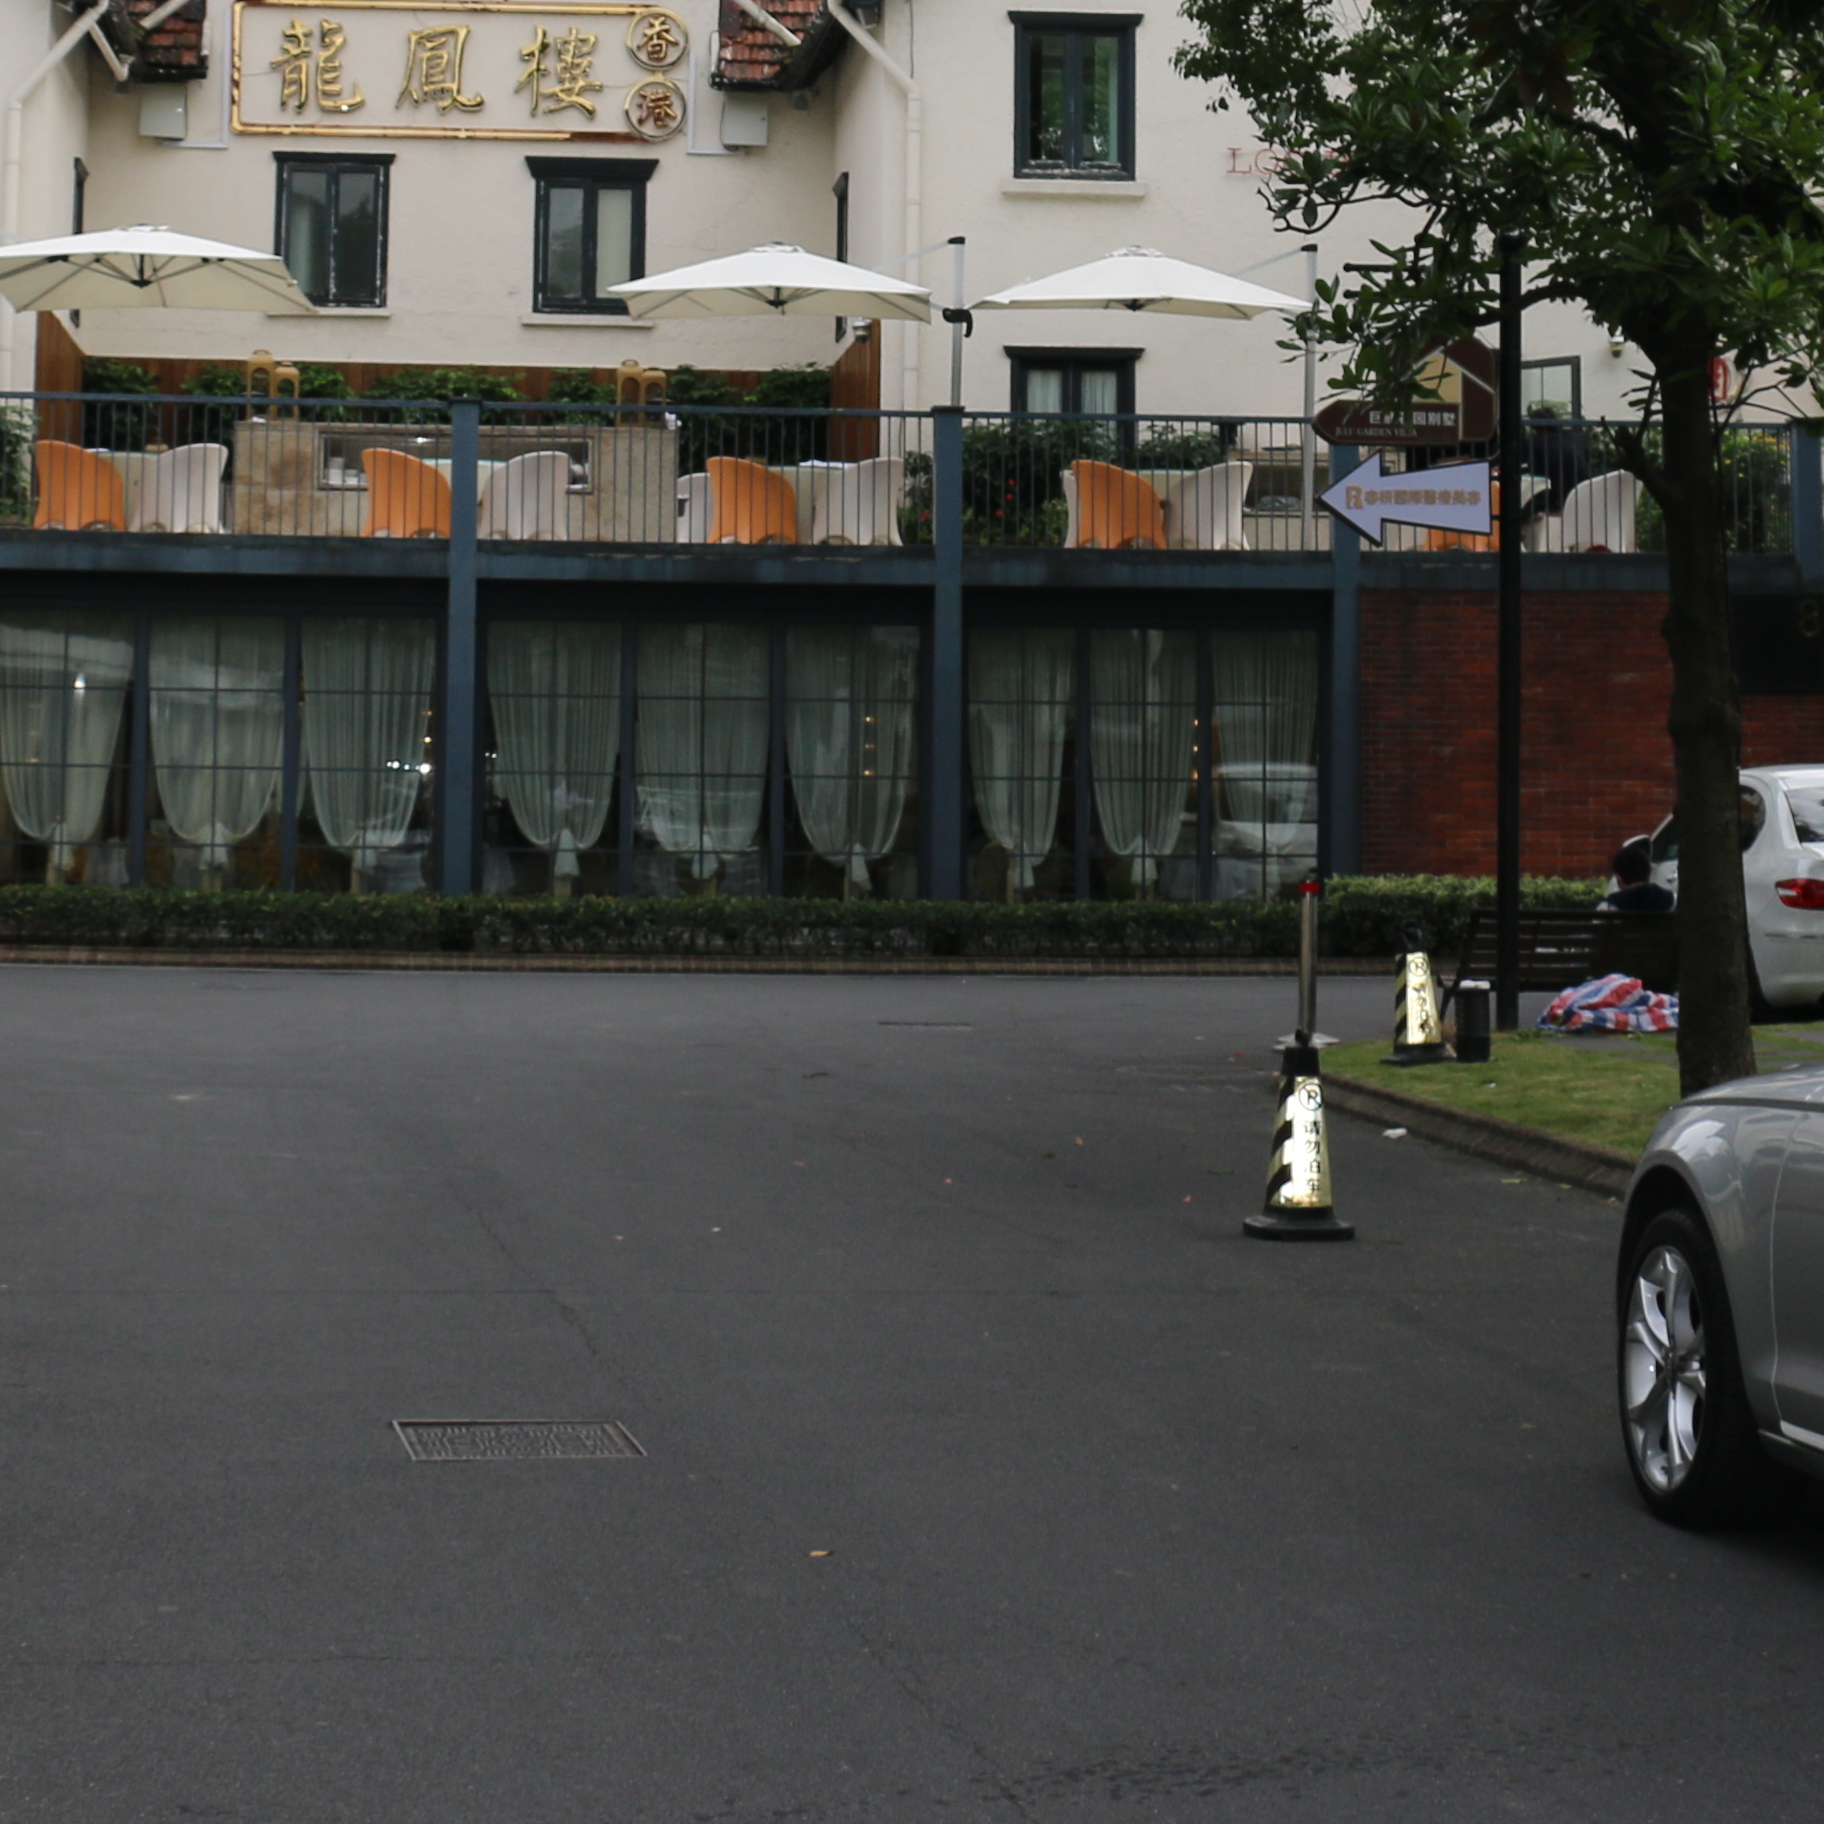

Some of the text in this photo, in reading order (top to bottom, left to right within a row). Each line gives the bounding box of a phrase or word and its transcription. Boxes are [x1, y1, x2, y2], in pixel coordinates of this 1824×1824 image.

[270, 18, 603, 120] 龍鳳樓
[635, 16, 679, 129] 香港
[1356, 426, 1392, 437] GARDEN
